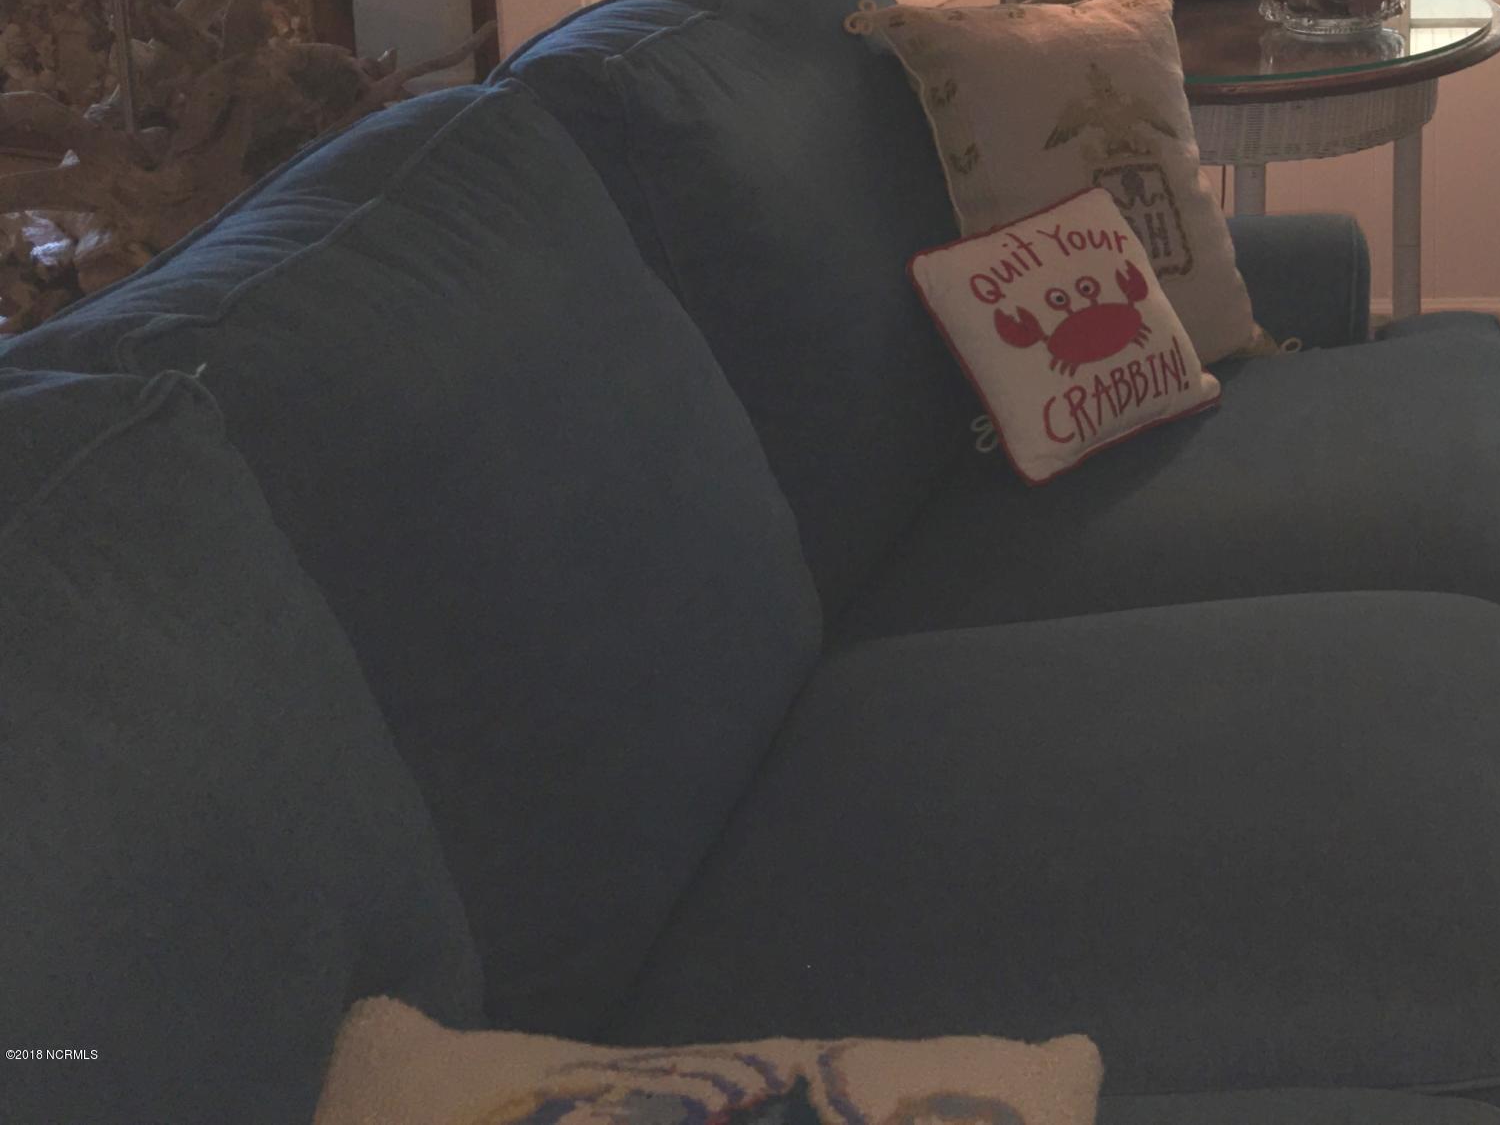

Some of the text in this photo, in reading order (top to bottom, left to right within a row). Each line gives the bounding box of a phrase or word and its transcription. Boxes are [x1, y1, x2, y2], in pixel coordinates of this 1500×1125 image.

[970, 224, 1128, 304] Quit Your
[1043, 335, 1189, 443] CRABBIN!
